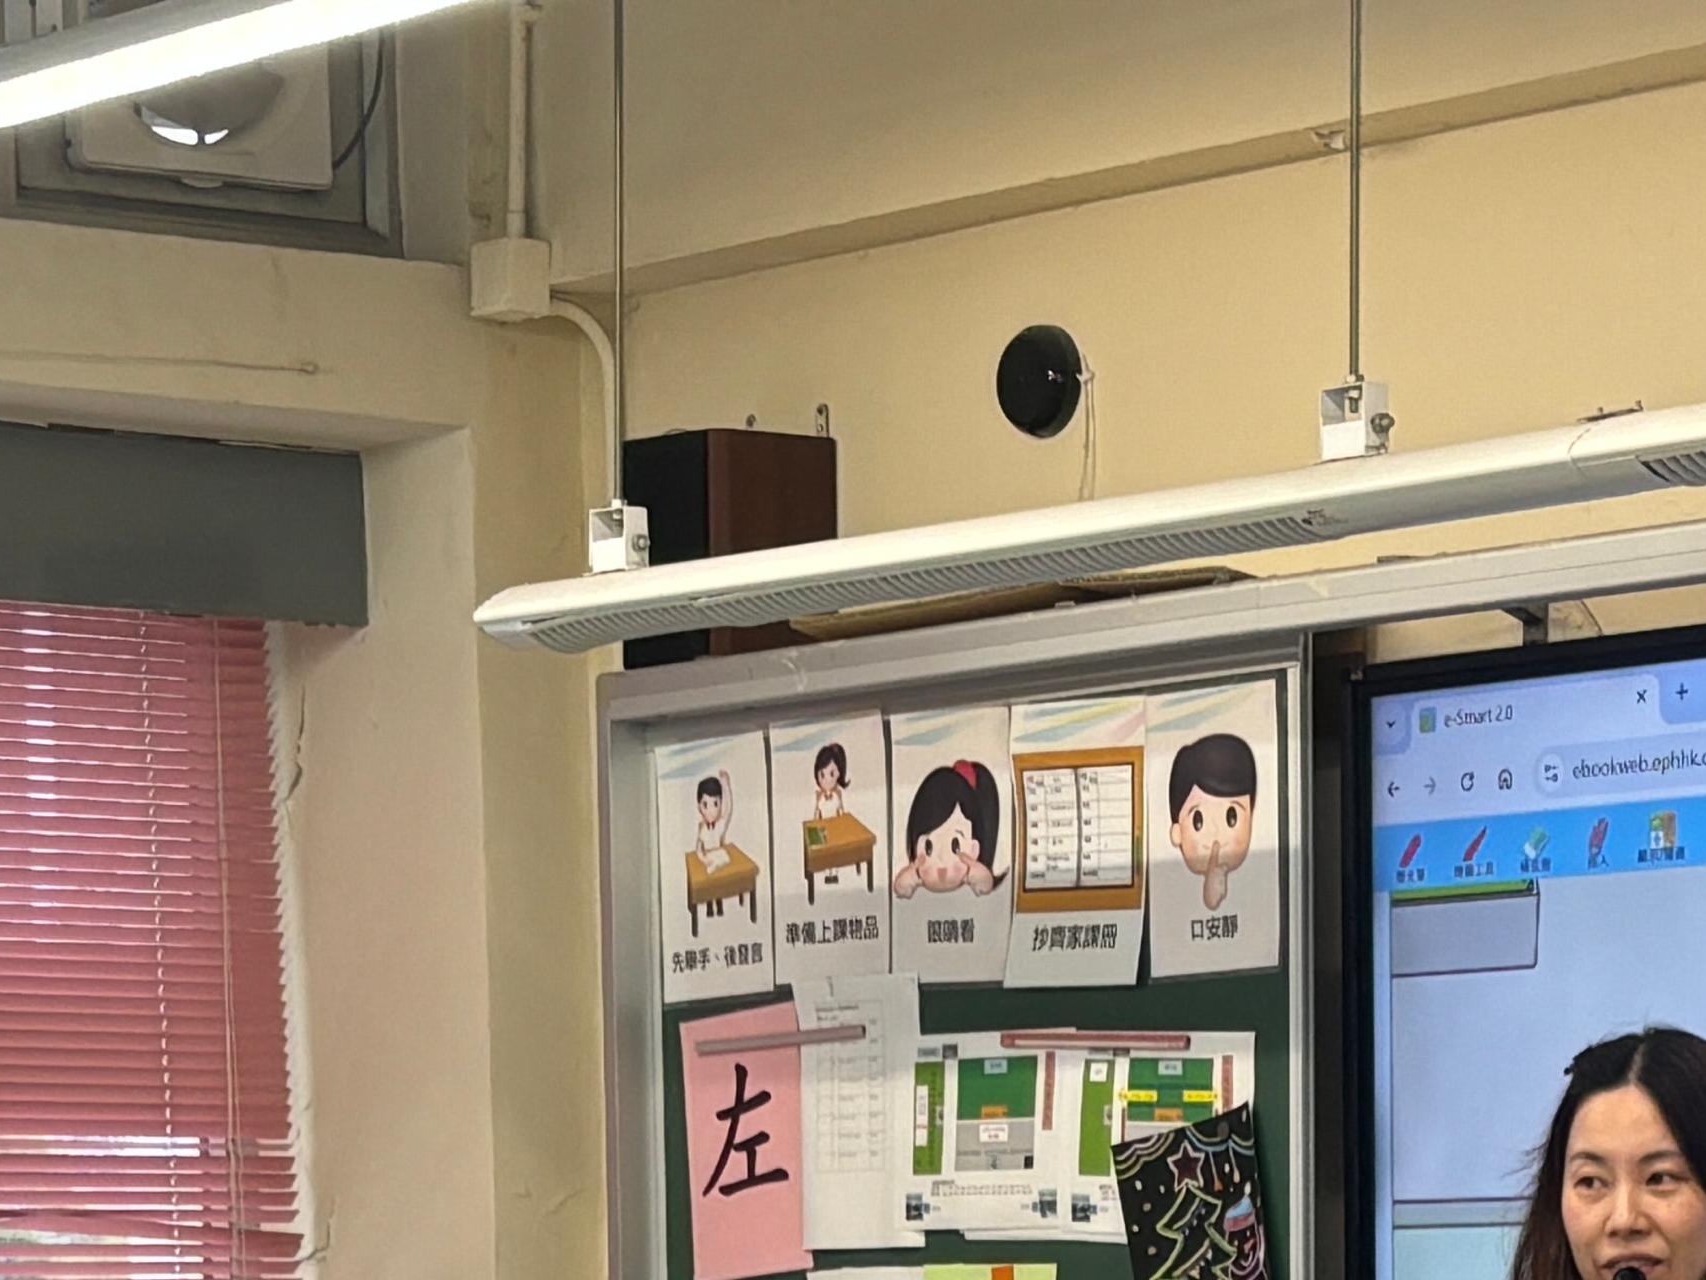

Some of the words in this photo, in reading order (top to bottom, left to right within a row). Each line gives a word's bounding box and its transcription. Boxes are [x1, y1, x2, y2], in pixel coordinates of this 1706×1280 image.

[1444, 713, 1492, 727] e-Smart
[1495, 707, 1513, 723] 2.0
[786, 915, 879, 946] 準備上課物品
[1190, 914, 1238, 941] 口安靜
[702, 1062, 789, 1197] 左
